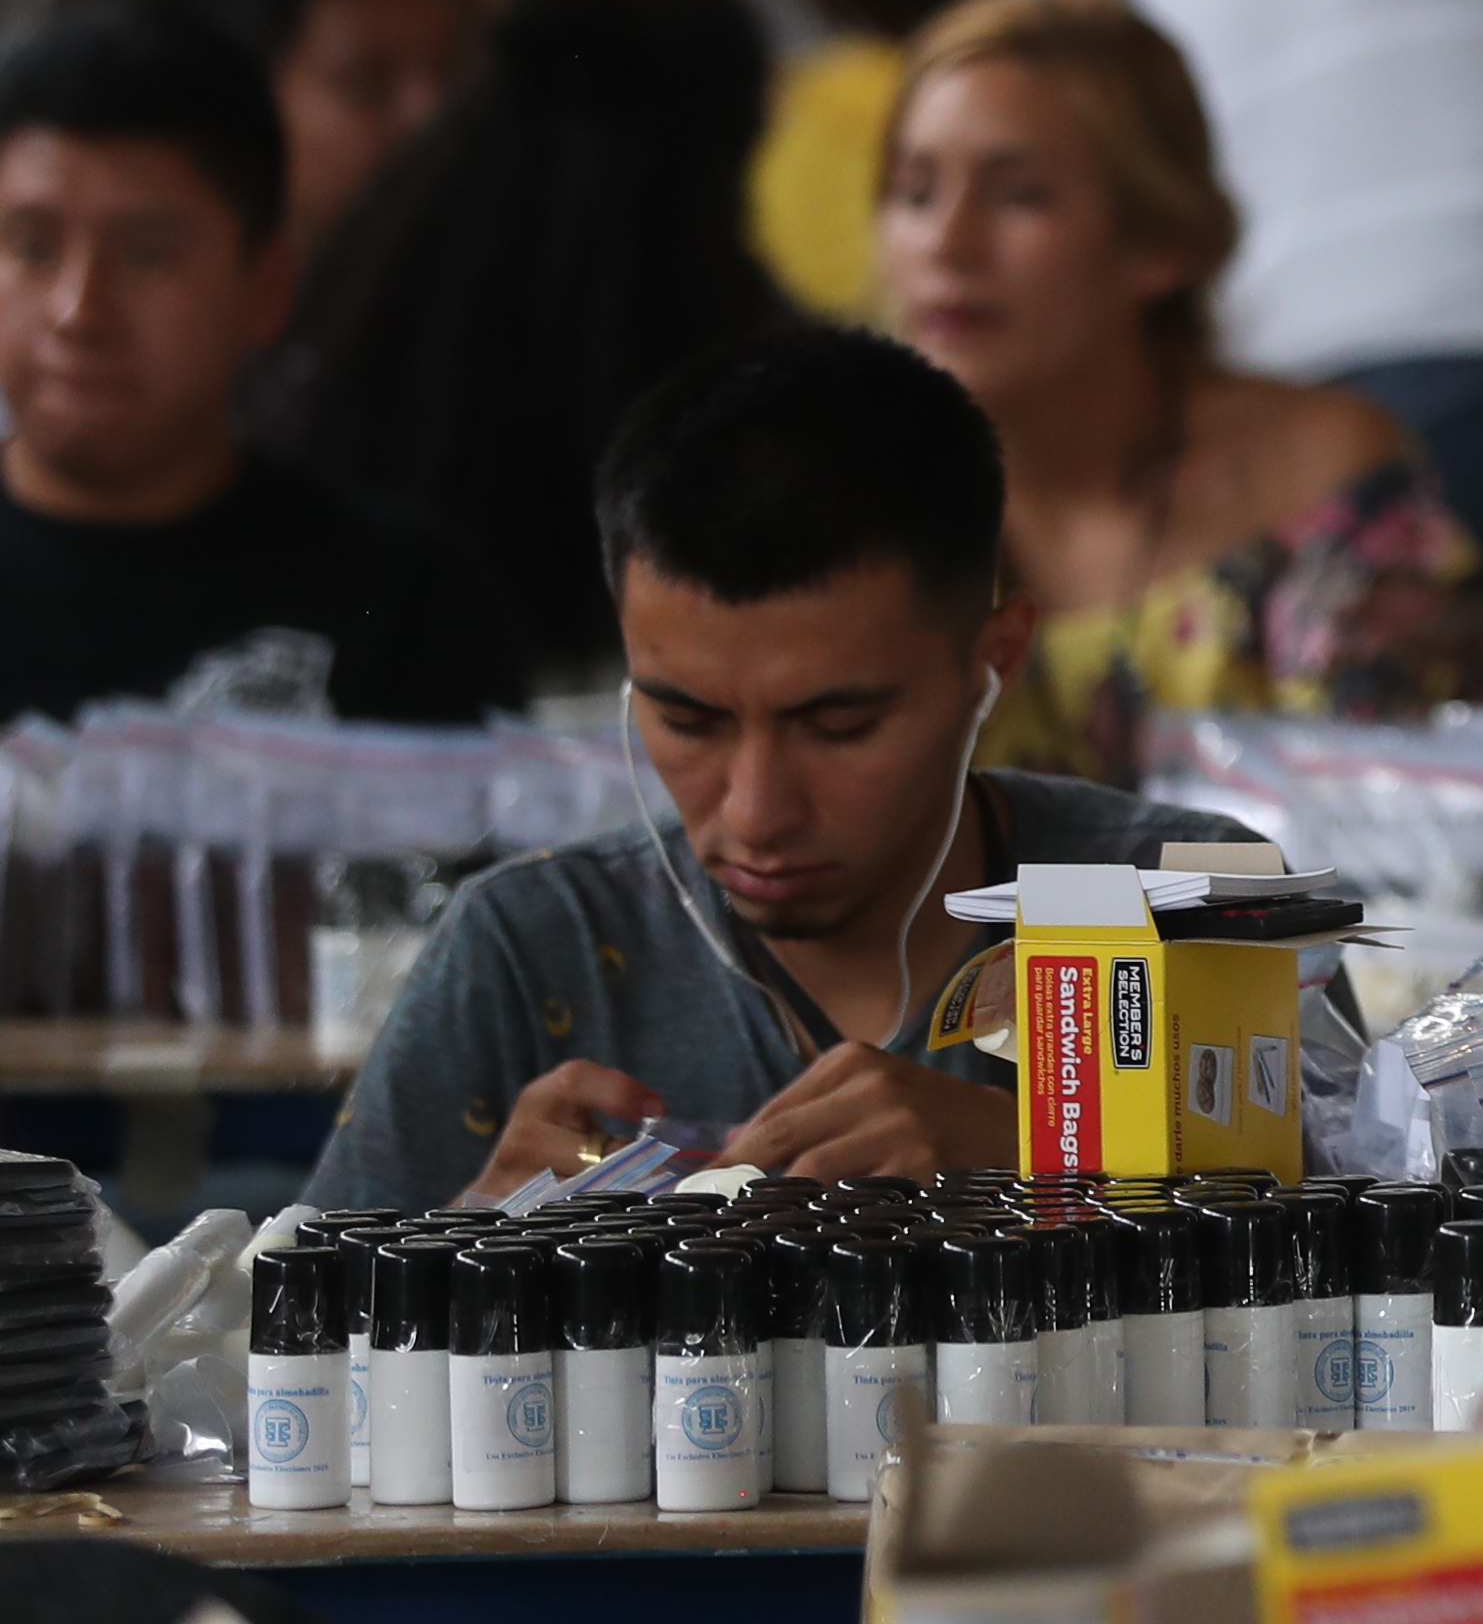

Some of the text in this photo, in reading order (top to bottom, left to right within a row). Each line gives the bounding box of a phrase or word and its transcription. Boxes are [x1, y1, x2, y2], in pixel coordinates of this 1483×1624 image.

[1034, 967, 1045, 1096] para guardar sandwiches
[1045, 967, 1057, 1127] Bolsas extra grandes con cierre
[1081, 967, 1094, 1055] Extra Large
[1118, 969, 1130, 1057] SELECTION
[1129, 965, 1145, 1061] MEMBER'S
[1172, 1013, 1181, 1051] usos
[1059, 966, 1082, 1168] Sandwich Bags
[1171, 1055, 1182, 1117] muchos
[1173, 1121, 1183, 1162] darle
[853, 1375, 878, 1384] Tinta
